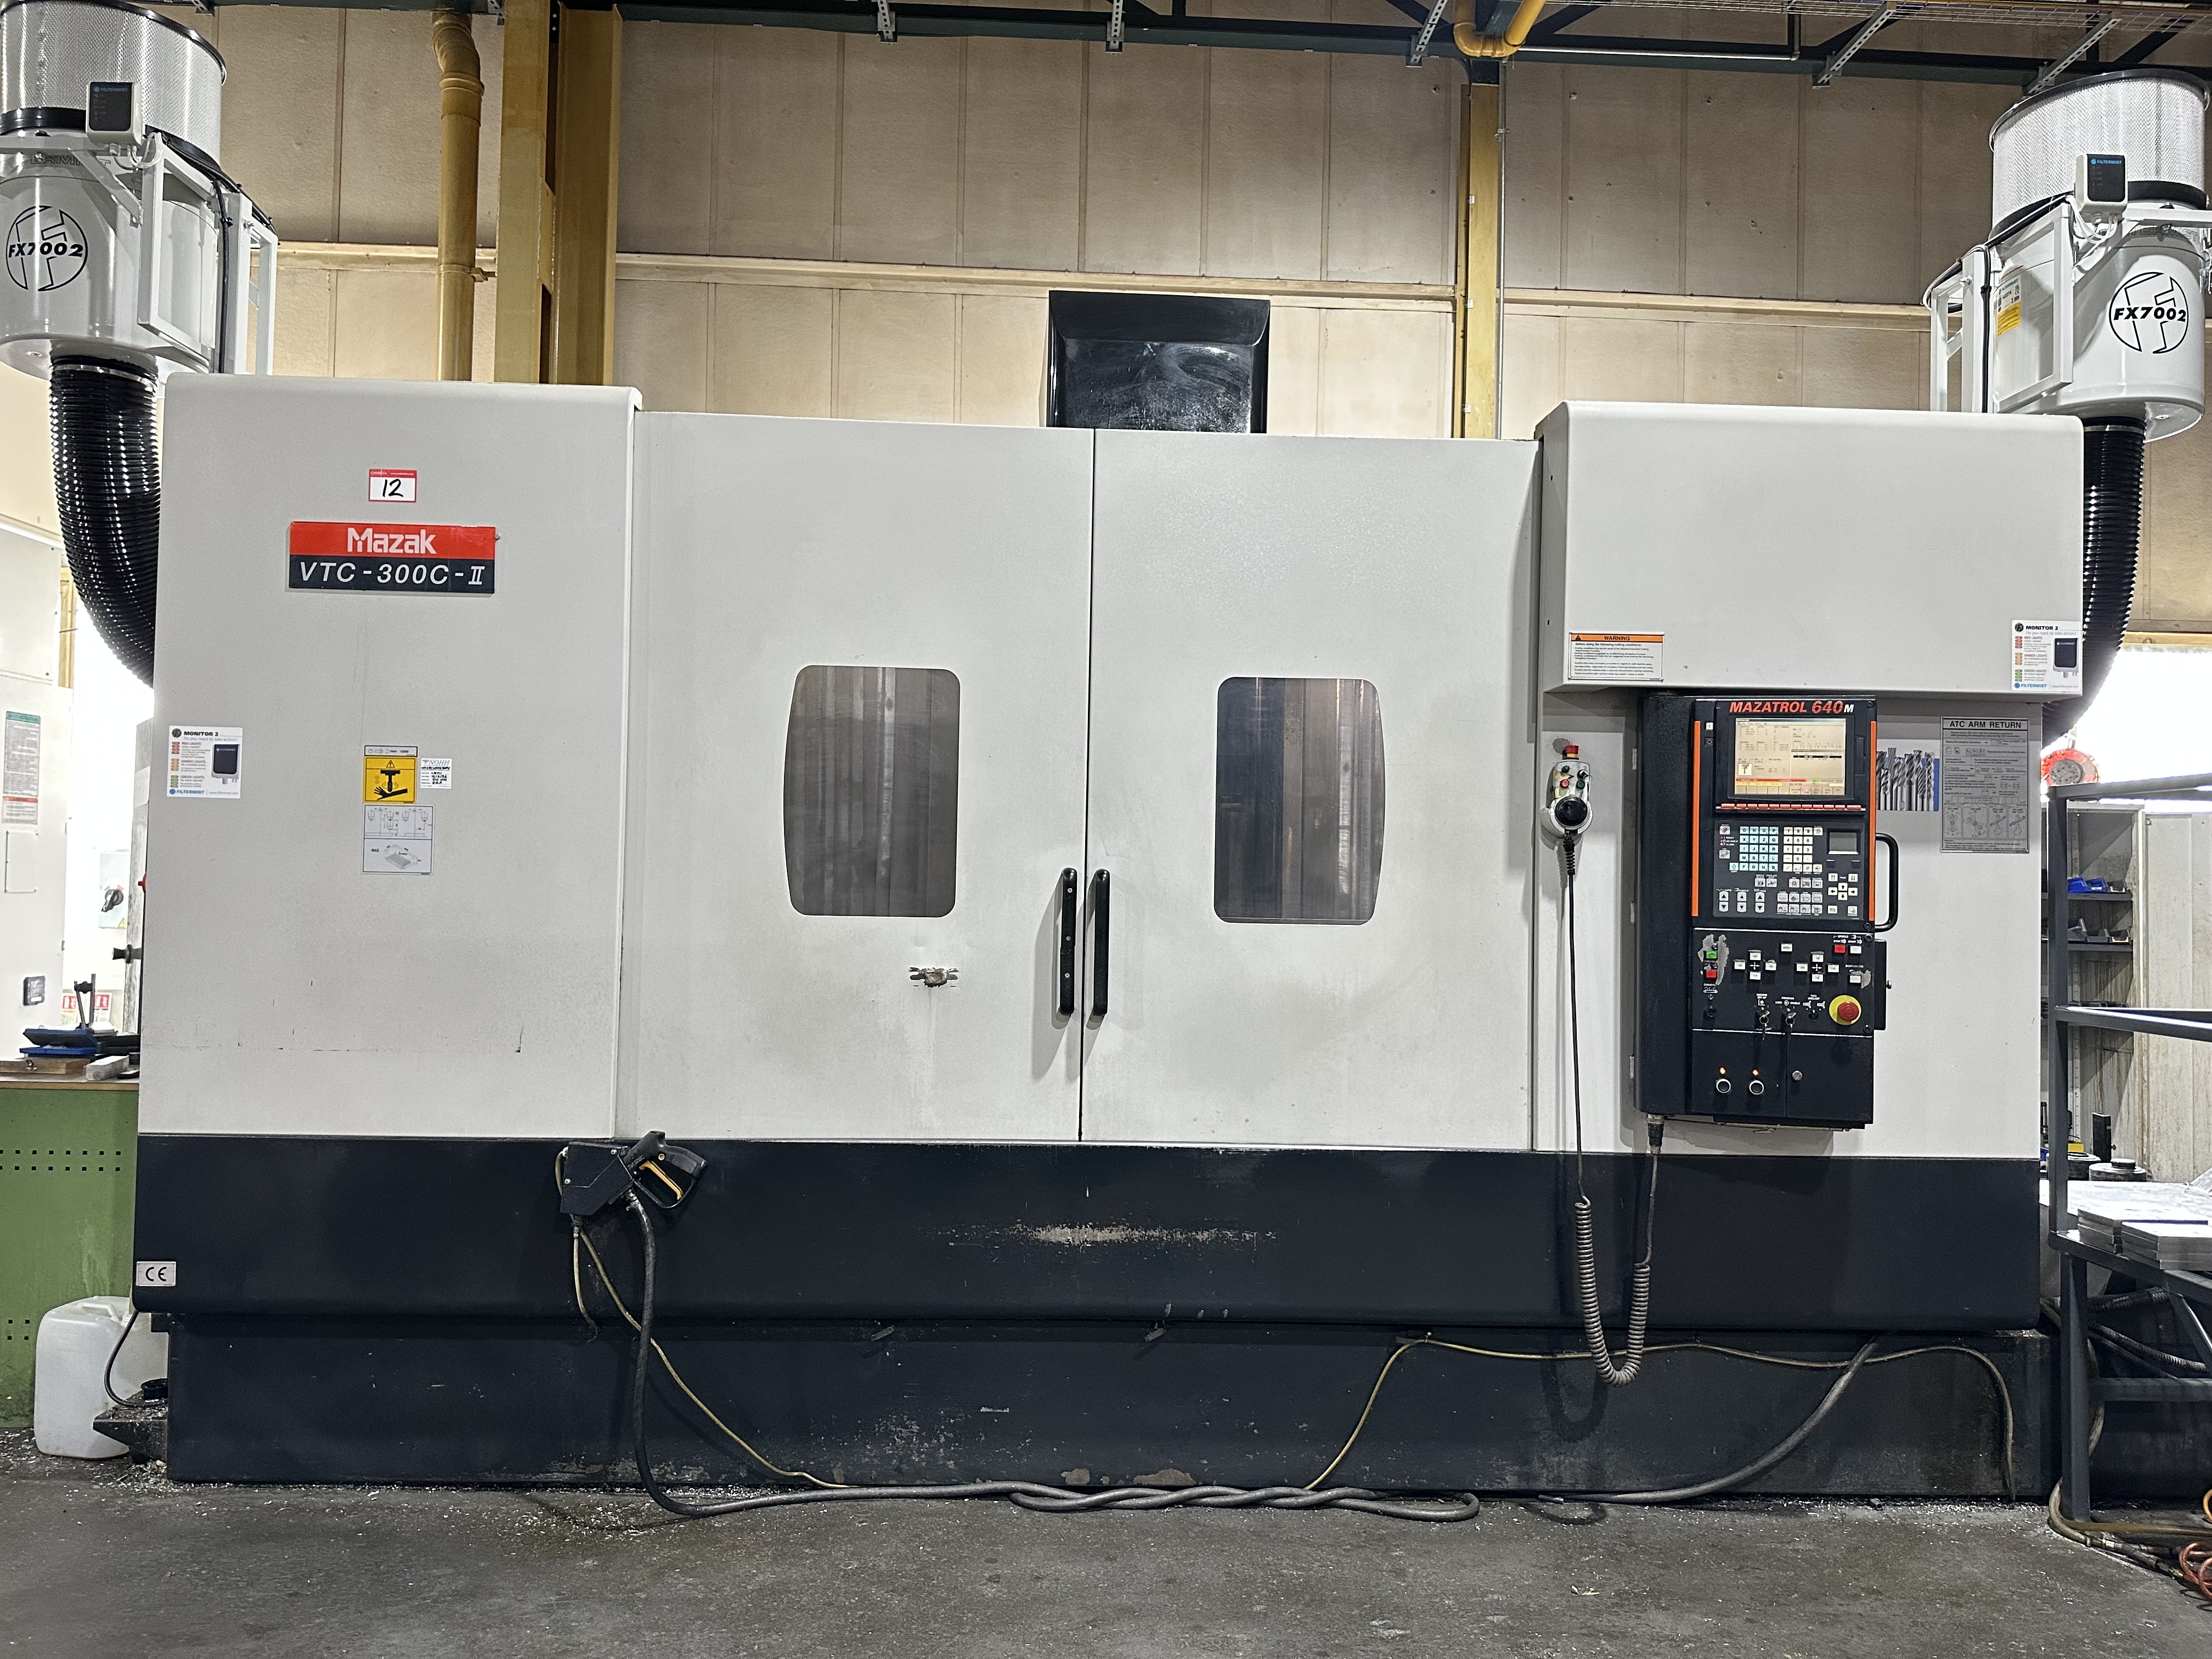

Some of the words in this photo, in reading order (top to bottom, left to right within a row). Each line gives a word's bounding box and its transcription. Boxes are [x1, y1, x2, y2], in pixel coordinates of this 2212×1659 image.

[8, 242, 83, 257] FX7002
[2114, 307, 2186, 322] FX7002
[382, 479, 403, 497] 12
[347, 527, 437, 554] Mazak
[1730, 702, 1807, 713] MAZATROL
[146, 1267, 166, 1281] CE
